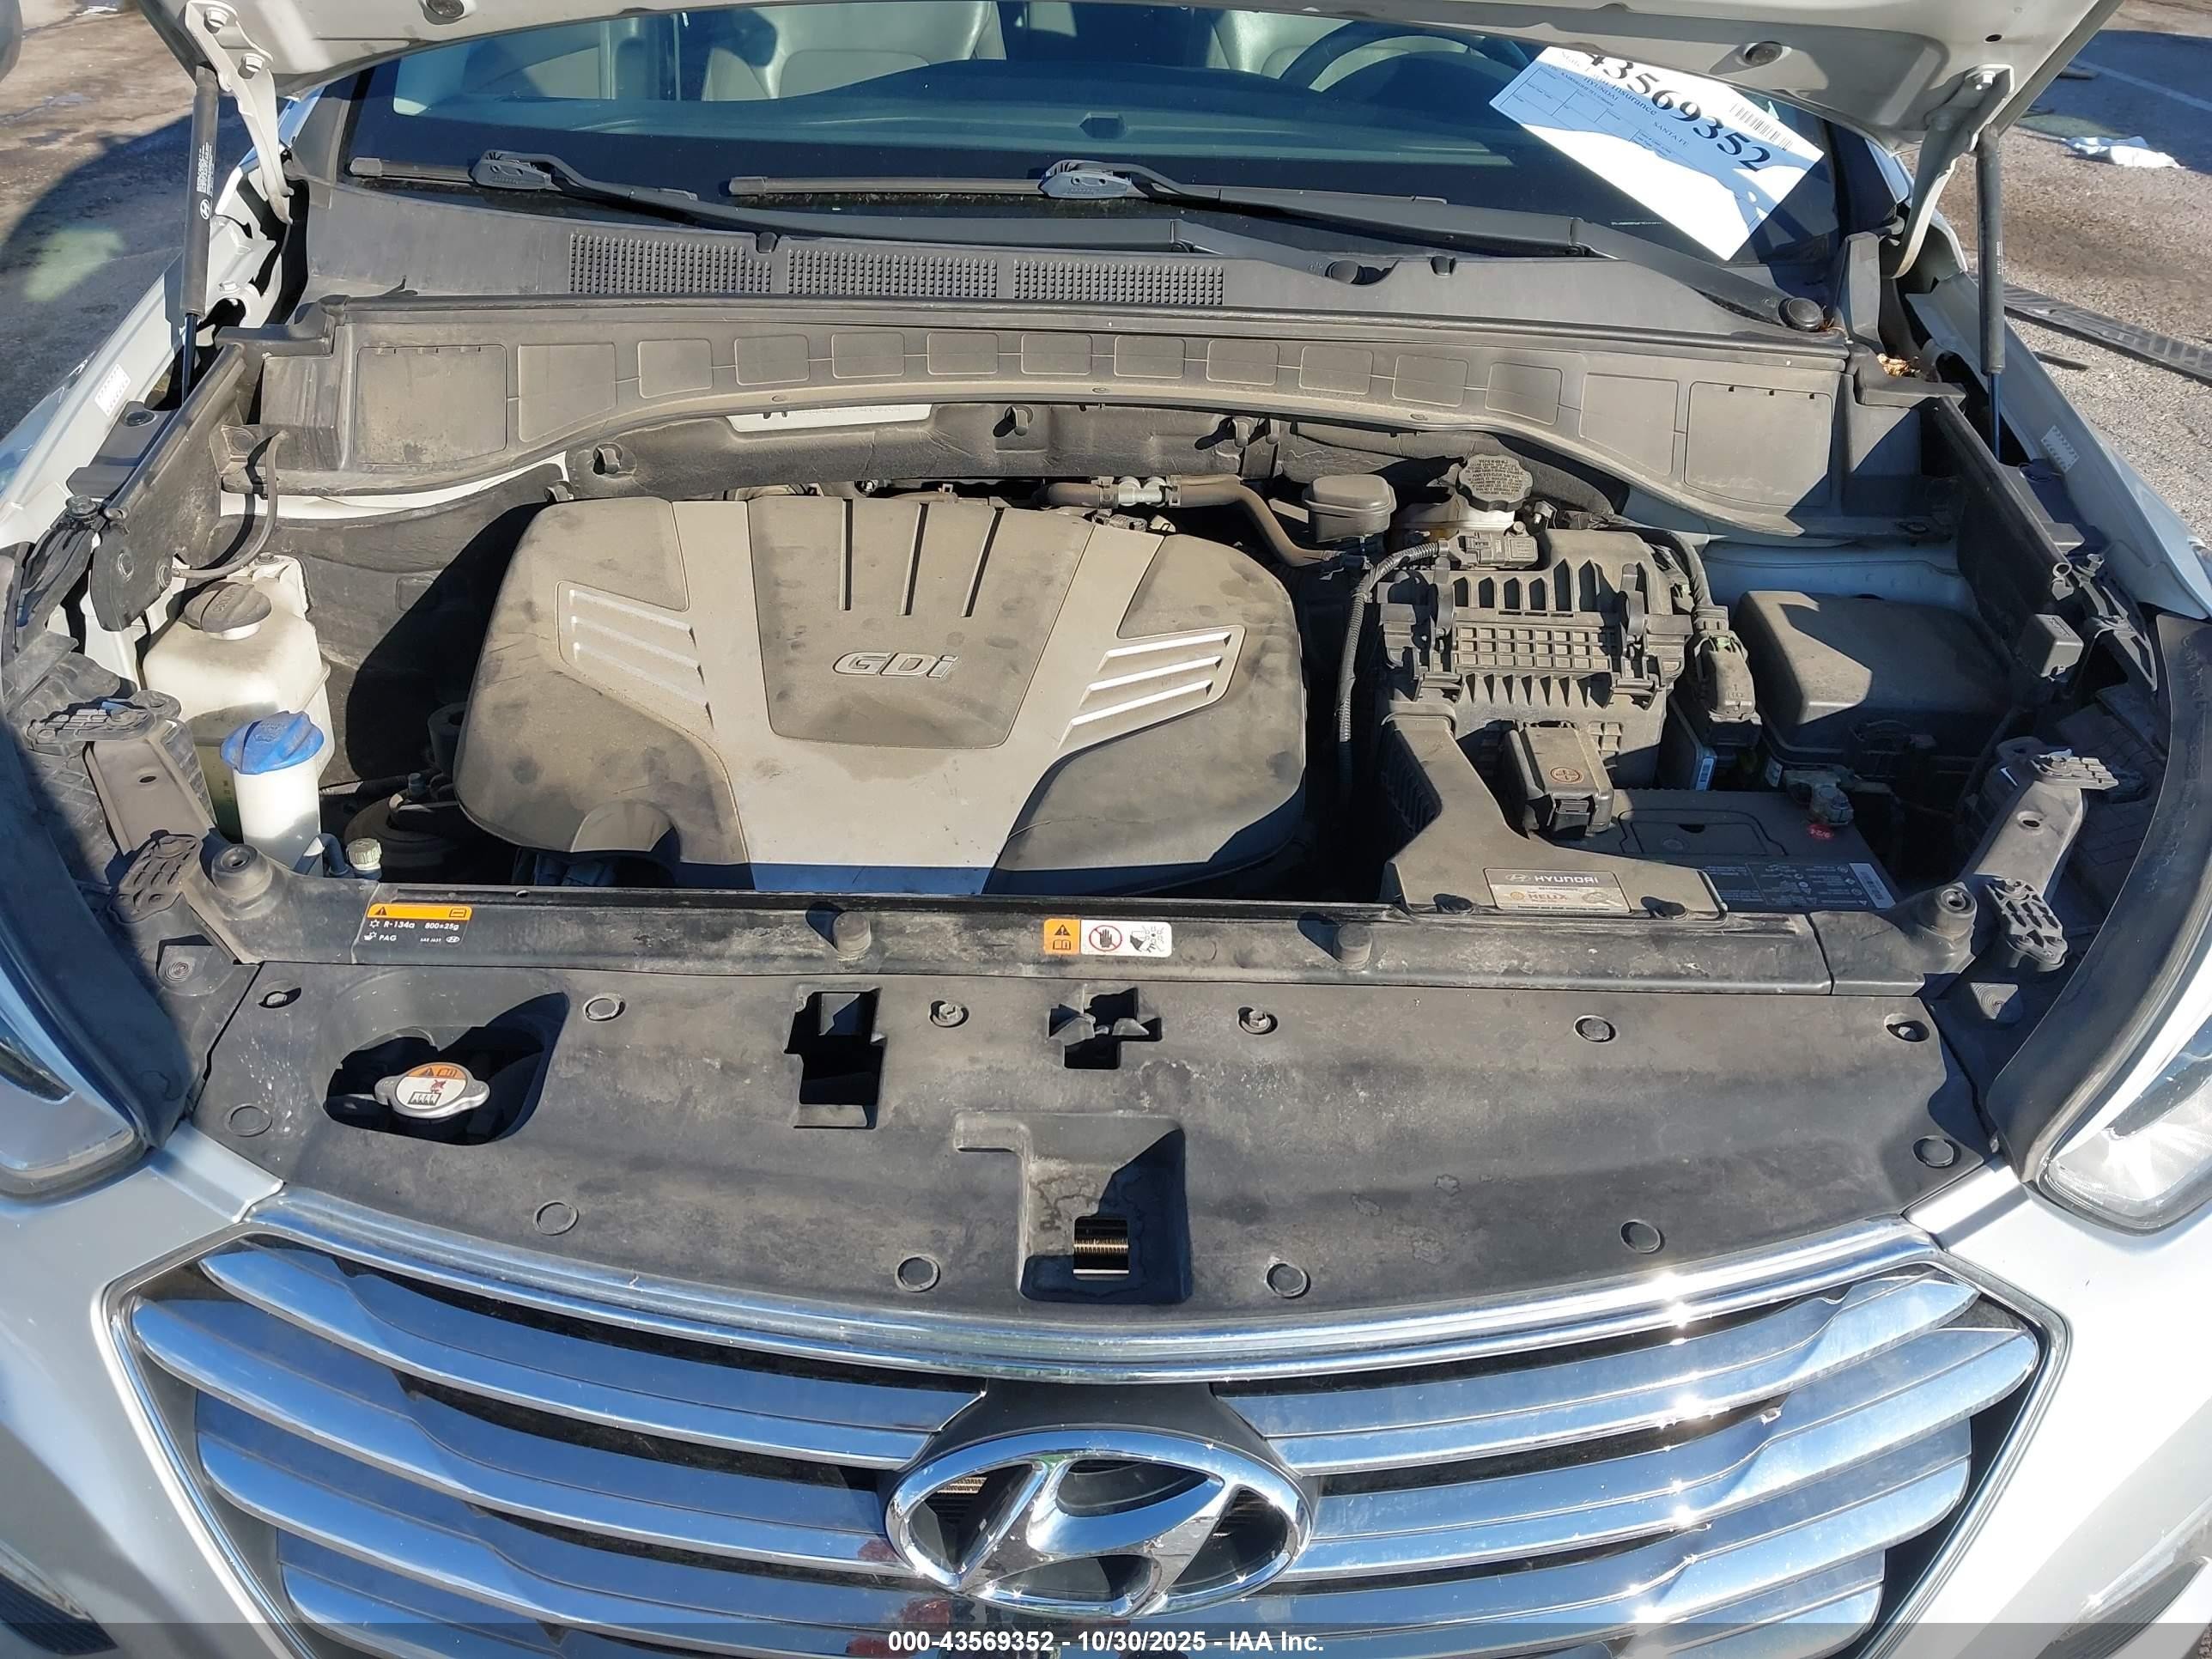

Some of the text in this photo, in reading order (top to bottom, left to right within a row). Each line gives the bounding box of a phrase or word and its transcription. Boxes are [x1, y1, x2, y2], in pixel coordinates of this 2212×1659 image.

[1583, 76, 1620, 102] HYUNDAI
[1611, 82, 1657, 117] Insurance
[832, 651, 959, 679] GDi
[1534, 875, 1599, 884] HYUNDAI
[424, 922, 459, 931] 800±25g
